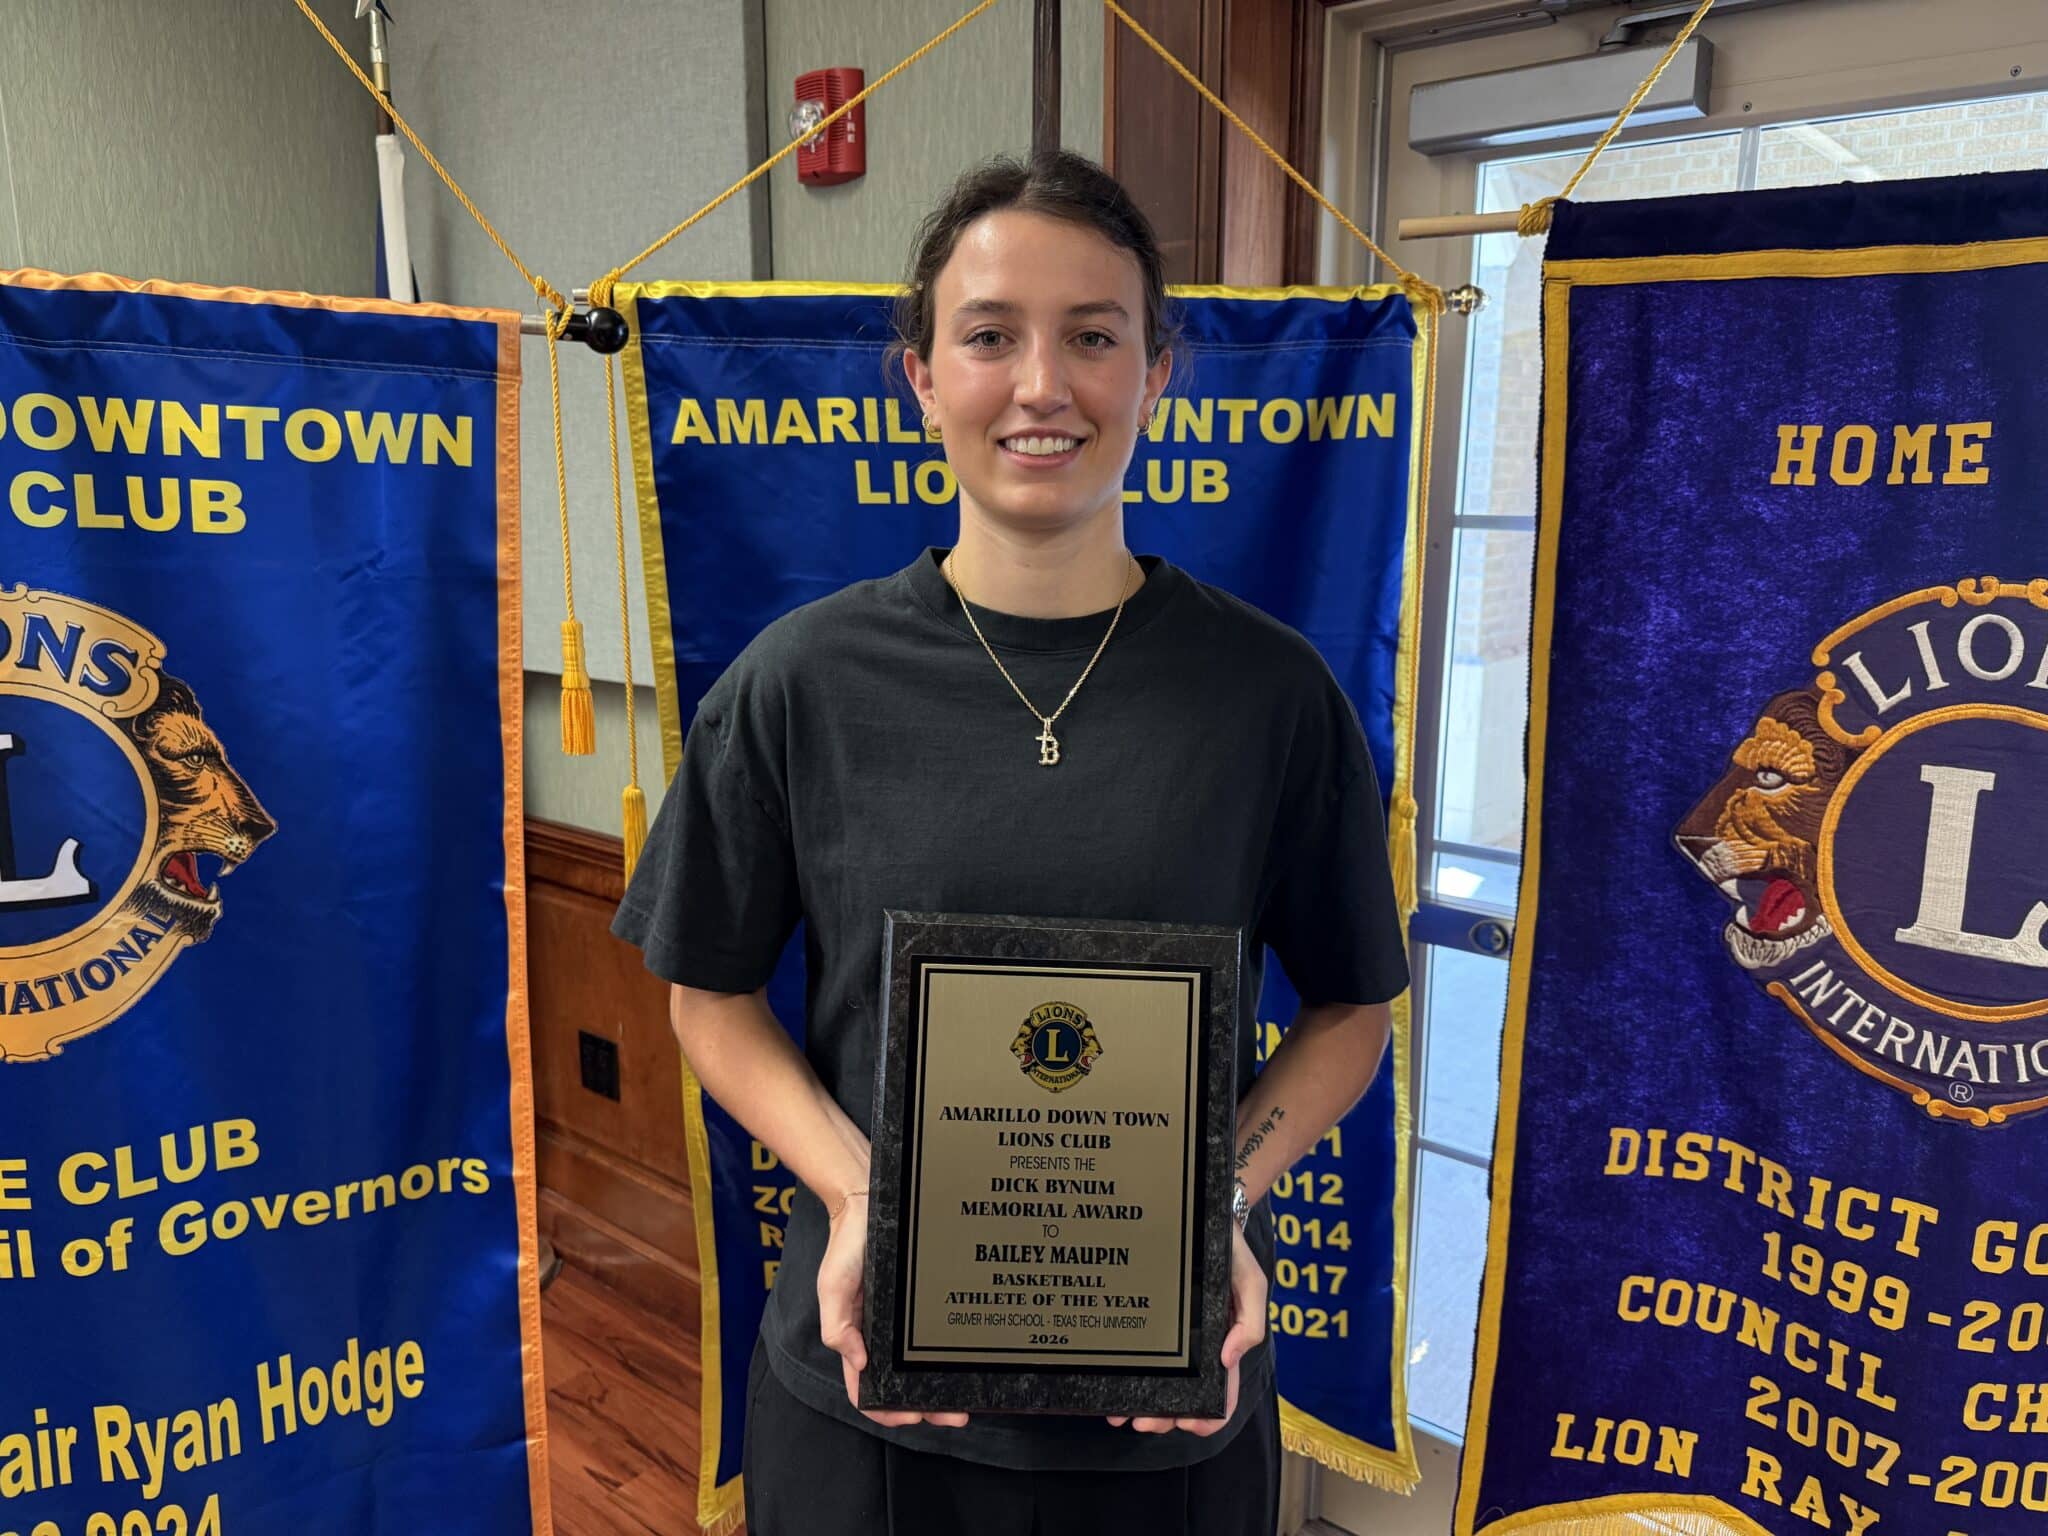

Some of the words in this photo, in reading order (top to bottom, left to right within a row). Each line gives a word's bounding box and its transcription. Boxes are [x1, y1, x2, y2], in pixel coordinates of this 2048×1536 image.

[0, 393, 473, 468] OWNTOWN
[671, 397, 943, 445] AMARIL
[1770, 421, 1992, 486] HOME
[9, 471, 247, 534] CLUB
[0, 612, 139, 696] NS
[1842, 613, 2048, 714] LIO
[1895, 764, 2048, 969] L
[0, 914, 177, 1016] ATIONAL
[1035, 1006, 1083, 1025] LIONS
[1045, 1028, 1069, 1062] L
[939, 1106, 1041, 1123] AMARILLO
[1048, 1108, 1106, 1125] DOWN
[1112, 1111, 1170, 1127] TOWN
[997, 1131, 1054, 1148] LIONS
[1060, 1133, 1112, 1149] CLUB
[58, 1117, 260, 1206] CLUB
[1010, 1155, 1070, 1171] PRESENTS
[1073, 1157, 1096, 1171] THE
[990, 1177, 1039, 1194] DICK
[1045, 1179, 1116, 1195] BYNUM
[1272, 1169, 1345, 1205] 012
[1604, 1127, 1940, 1258] DISTRICT
[61, 1217, 134, 1277] of
[159, 1157, 490, 1256] Governors
[960, 1201, 1067, 1218] MEMORIAL
[1072, 1204, 1143, 1221] AWARD
[1042, 1224, 1060, 1239] TO
[1271, 1212, 1352, 1251] 014
[975, 1244, 1046, 1264] BAILEY
[1050, 1246, 1130, 1266] MAUPIN
[992, 1272, 1106, 1288] BASKETBALL
[1276, 1258, 1348, 1295] 017
[1761, 1231, 2048, 1354] 1999-20
[945, 1291, 1027, 1305] ATHLETE
[1032, 1293, 1056, 1307] OF
[1060, 1294, 1099, 1308] THE
[1103, 1295, 1150, 1310] YEAR
[947, 1312, 983, 1326] GRUVER
[984, 1312, 1006, 1326] HIGH
[1007, 1313, 1045, 1328] SCHOOL
[1052, 1314, 1077, 1328] TEXAS
[1079, 1315, 1101, 1329] TECH
[1103, 1315, 1147, 1329] UNIVERSITY
[1028, 1333, 1069, 1345] 2026
[1617, 1275, 1897, 1412] COUNCIL
[93, 1396, 242, 1500] Ryan
[255, 1337, 425, 1445] Hodge
[1550, 1412, 1698, 1478] LION
[1741, 1446, 1881, 1536] RAY
